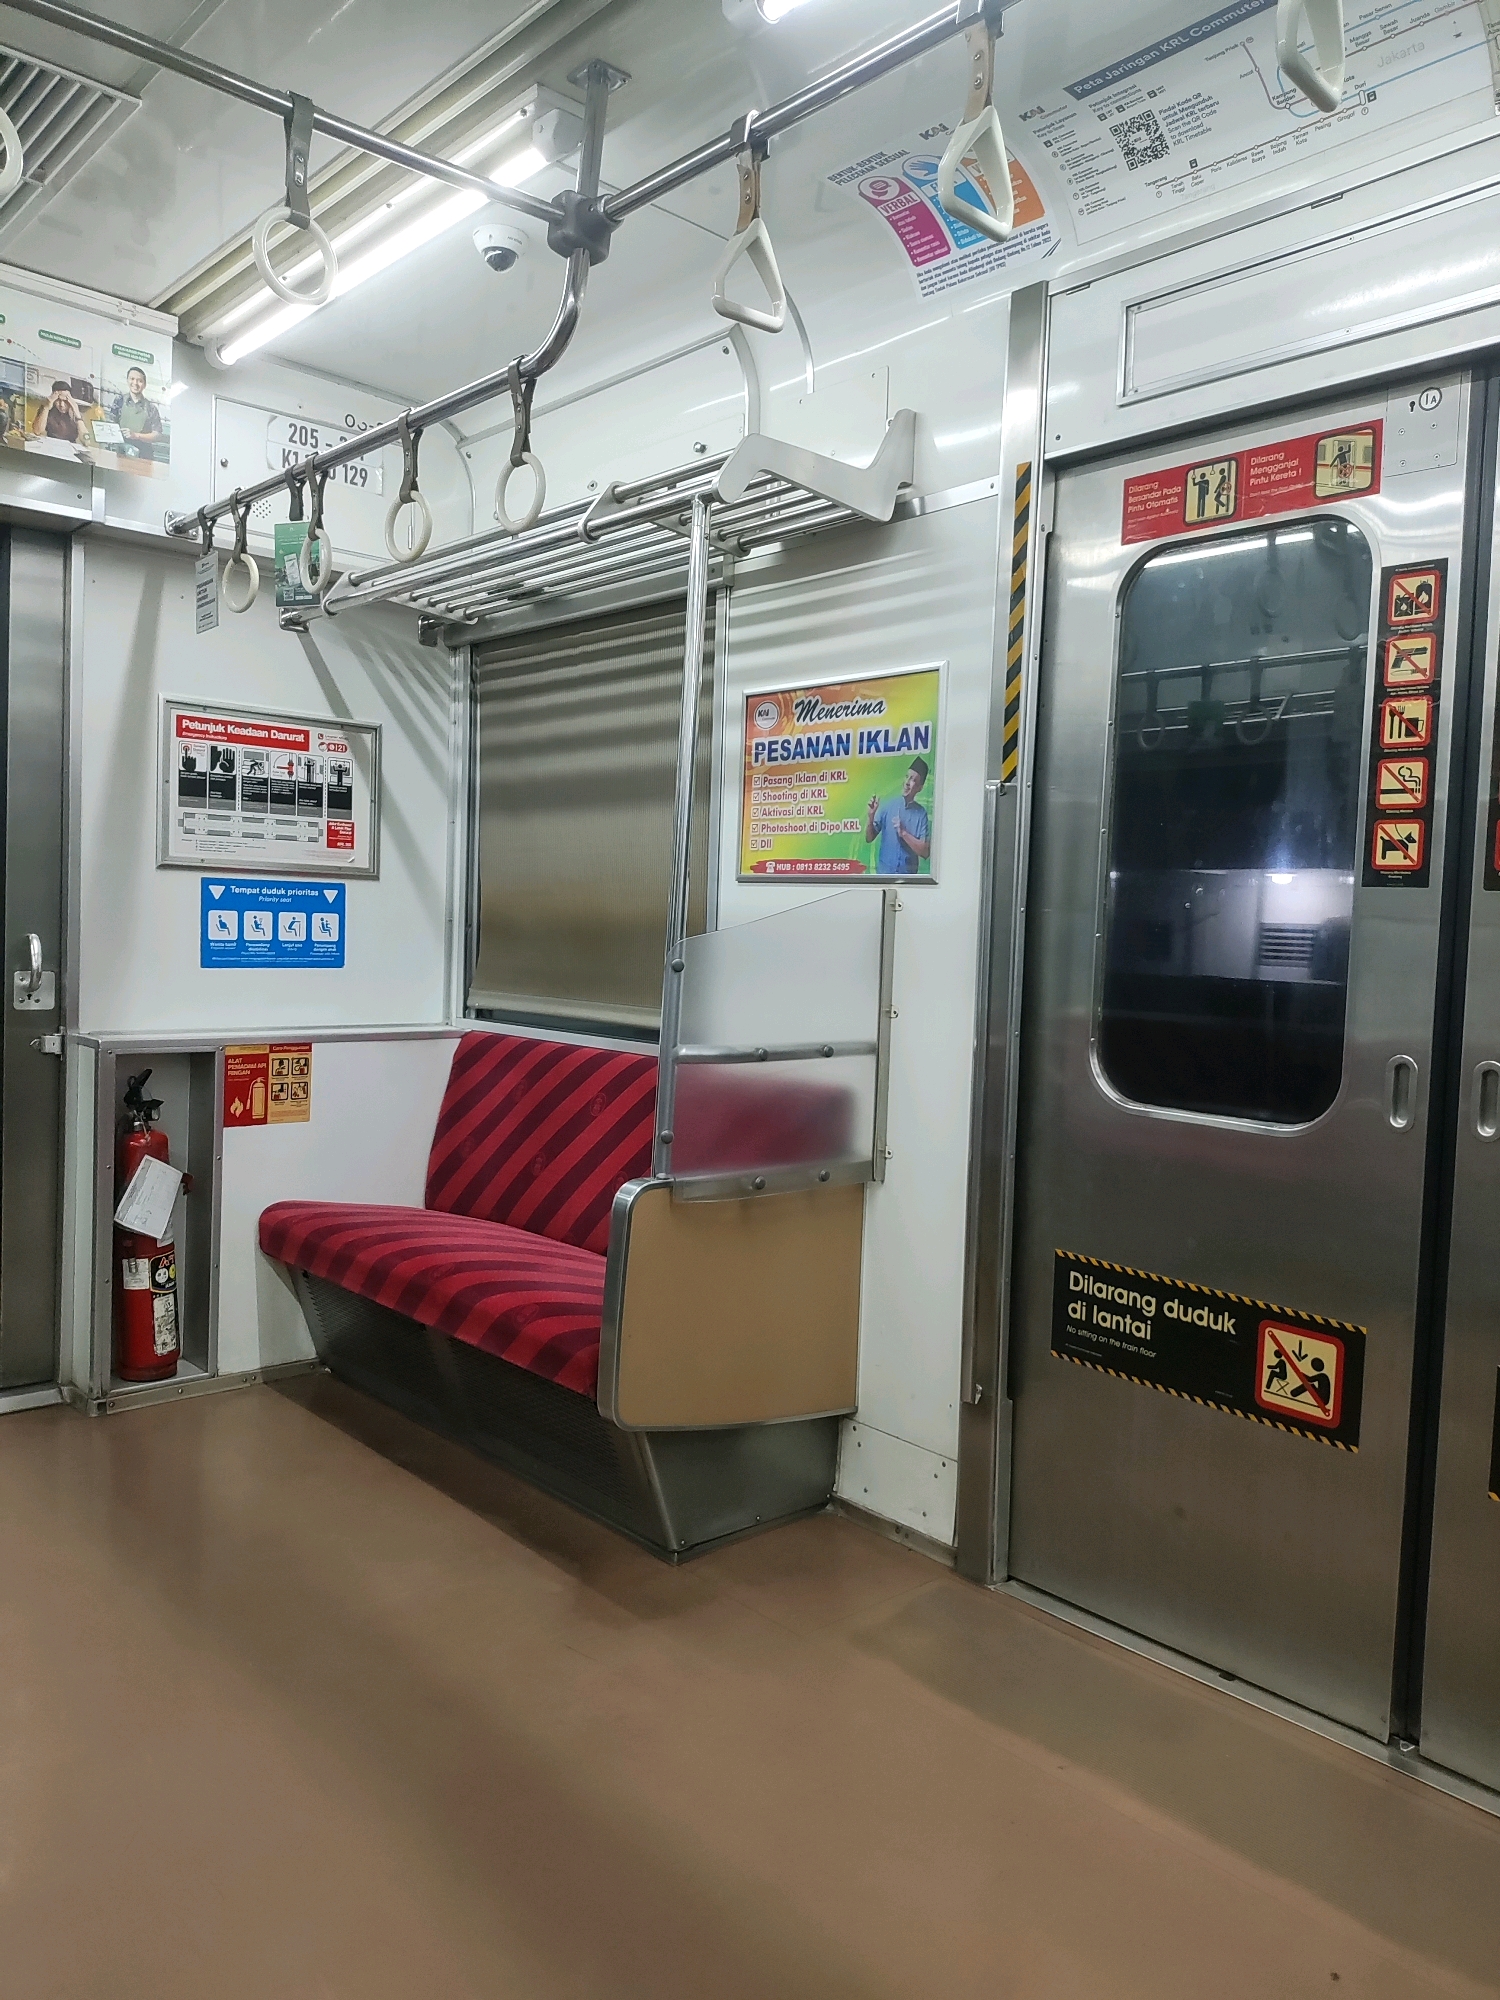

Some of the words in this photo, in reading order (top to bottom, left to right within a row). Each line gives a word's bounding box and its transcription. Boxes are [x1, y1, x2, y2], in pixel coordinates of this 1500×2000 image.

[1409, 12, 1431, 24] Juanda
[1073, 77, 1104, 94] Peta
[1105, 50, 1161, 81] Jaringan
[1159, 35, 1190, 53] KRL
[1377, 42, 1426, 69] Jakarta
[1354, 81, 1367, 90] Duri
[1158, 104, 1177, 115] Pindai
[1176, 98, 1193, 107] Kode
[1192, 92, 1203, 100] QR
[1161, 111, 1179, 121] untuk
[1178, 96, 1214, 114] Mengunduh
[1165, 115, 1186, 128] Jadwal
[1185, 110, 1198, 118] KRL
[1167, 125, 1182, 134] Scan
[1191, 115, 1202, 123] QR
[1201, 109, 1217, 119] Code
[1336, 111, 1356, 122] Grogol
[1177, 122, 1204, 137] download
[1314, 122, 1332, 132] Pesing
[1173, 138, 1185, 147] KRL
[1184, 127, 1212, 141] Timetable
[827, 151, 888, 182] BENTUK-BENTUK
[835, 164, 878, 186] PELECEHAN
[874, 150, 911, 167] SEKSUAL
[880, 194, 917, 214] VERBAL
[288, 422, 319, 449] 205
[1250, 458, 1299, 476] Mengganjal
[1251, 452, 1285, 465] Dilarang
[342, 464, 368, 488] 129
[1249, 476, 1269, 487] Pintu
[1270, 470, 1297, 482] Kereta
[1128, 481, 1159, 494] Dilarang
[1128, 490, 1162, 504] Bersandar
[1162, 486, 1182, 496] Pada
[1127, 504, 1145, 514] Pintu
[1145, 496, 1179, 509] Otomatis
[794, 698, 886, 723] Menerima
[182, 718, 226, 733] Petunjuk
[227, 724, 268, 738] Keadaan
[270, 731, 306, 742] Darurat
[754, 732, 851, 763] PESANAN
[858, 725, 930, 755] IKLAN
[763, 775, 792, 787] Pasang
[795, 773, 817, 783] Iklan
[819, 771, 828, 782] di
[830, 770, 847, 781] KRL
[762, 791, 798, 802] Shooting
[800, 789, 809, 800] di
[811, 788, 827, 799] KRL
[761, 806, 794, 817] Aktivasi
[796, 806, 805, 816] di
[807, 805, 823, 815] KRL
[761, 822, 807, 833] Photoshoot
[809, 822, 818, 832] di
[820, 821, 840, 833] Dipo
[843, 820, 860, 831] KRL
[776, 863, 791, 872] HUB
[796, 863, 813, 872] 0813
[813, 862, 832, 872] 8232
[230, 885, 260, 895] Tempat
[261, 886, 286, 896] duduk
[287, 887, 319, 898] prioritas
[258, 895, 280, 903] Priority
[1069, 1270, 1157, 1318] Dilarang
[1163, 1298, 1237, 1336] duduk
[1067, 1300, 1088, 1322] di
[1092, 1304, 1152, 1341] lantai
[1066, 1324, 1077, 1334] No
[1077, 1327, 1098, 1342] sitting
[1098, 1335, 1109, 1344] on
[1109, 1337, 1121, 1348] the
[1121, 1341, 1139, 1353] train
[1139, 1346, 1157, 1358] floor
